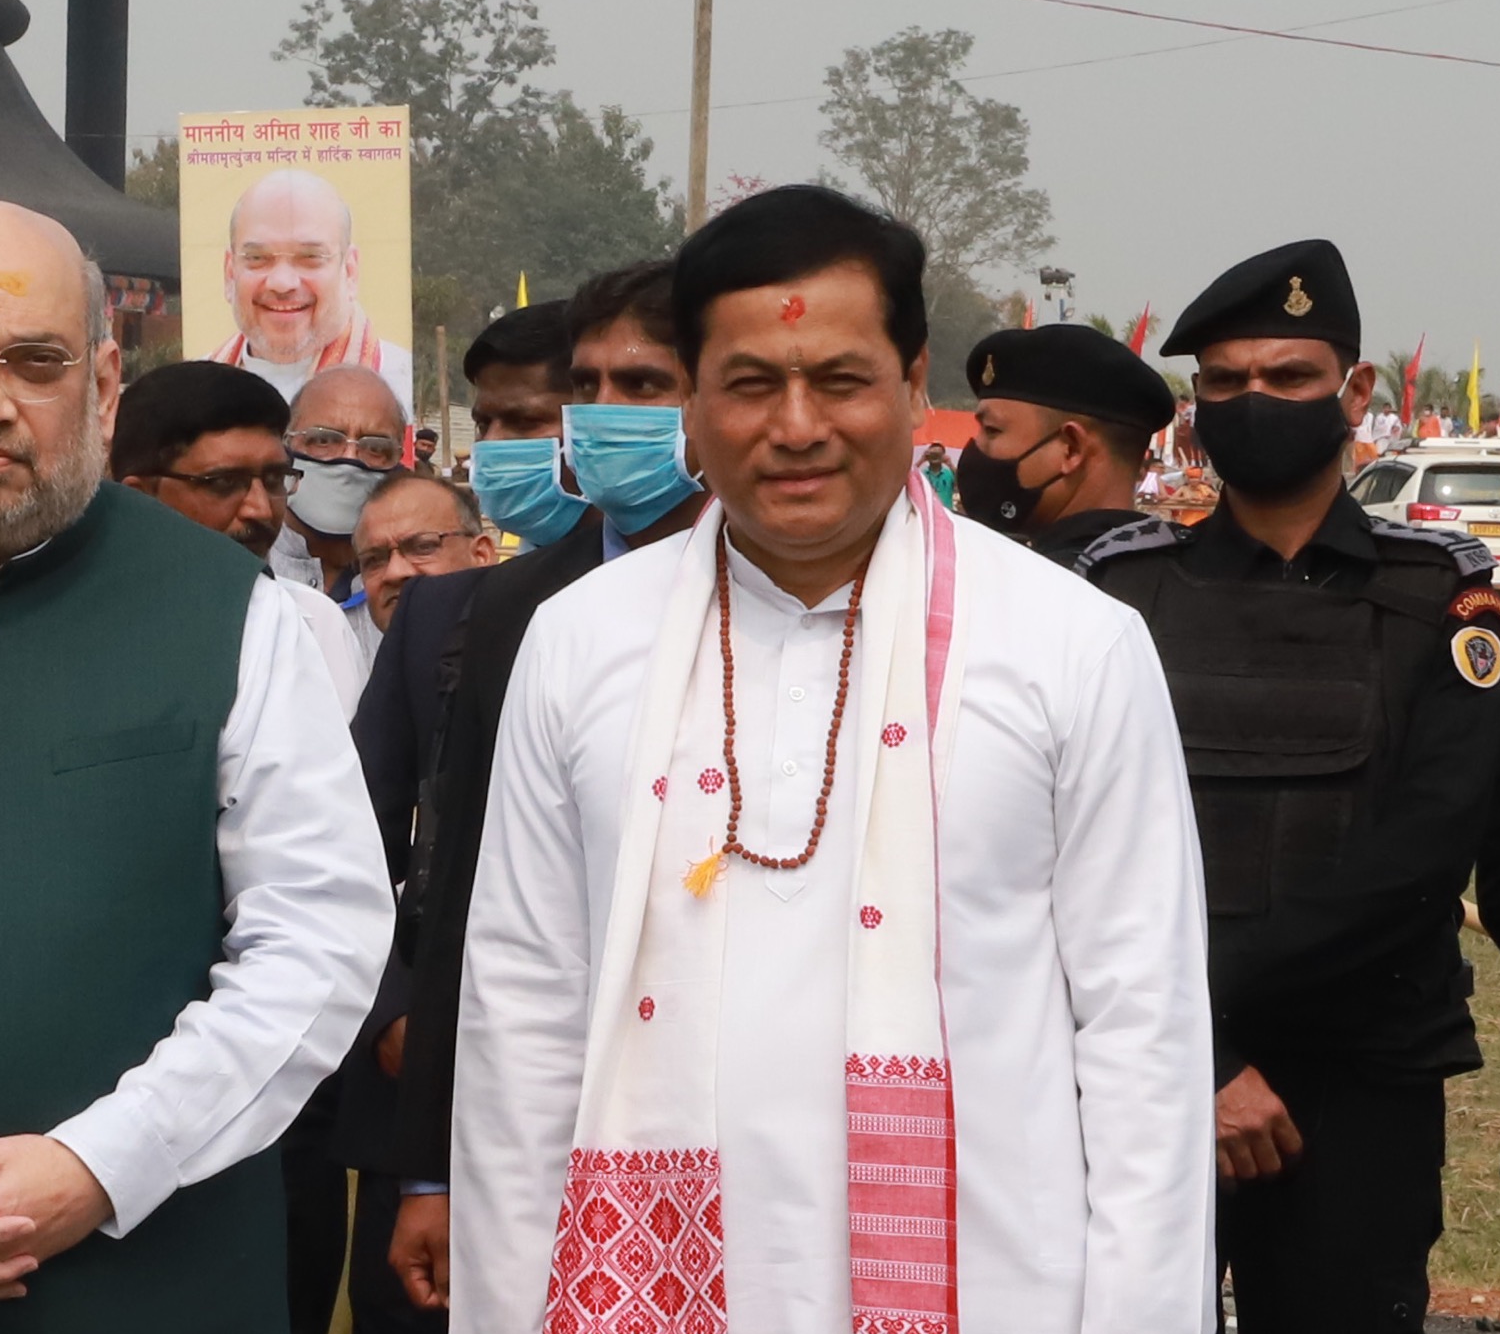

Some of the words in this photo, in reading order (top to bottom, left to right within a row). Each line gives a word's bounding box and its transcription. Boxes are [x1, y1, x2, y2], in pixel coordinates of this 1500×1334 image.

[183, 118, 245, 143] माननीय
[253, 117, 301, 142] अमित
[307, 121, 342, 142] शाह
[347, 115, 370, 139] जी
[376, 119, 402, 138] का
[266, 146, 298, 165] मन्दिर
[301, 145, 312, 163] में
[357, 146, 402, 162] स्वागतम
